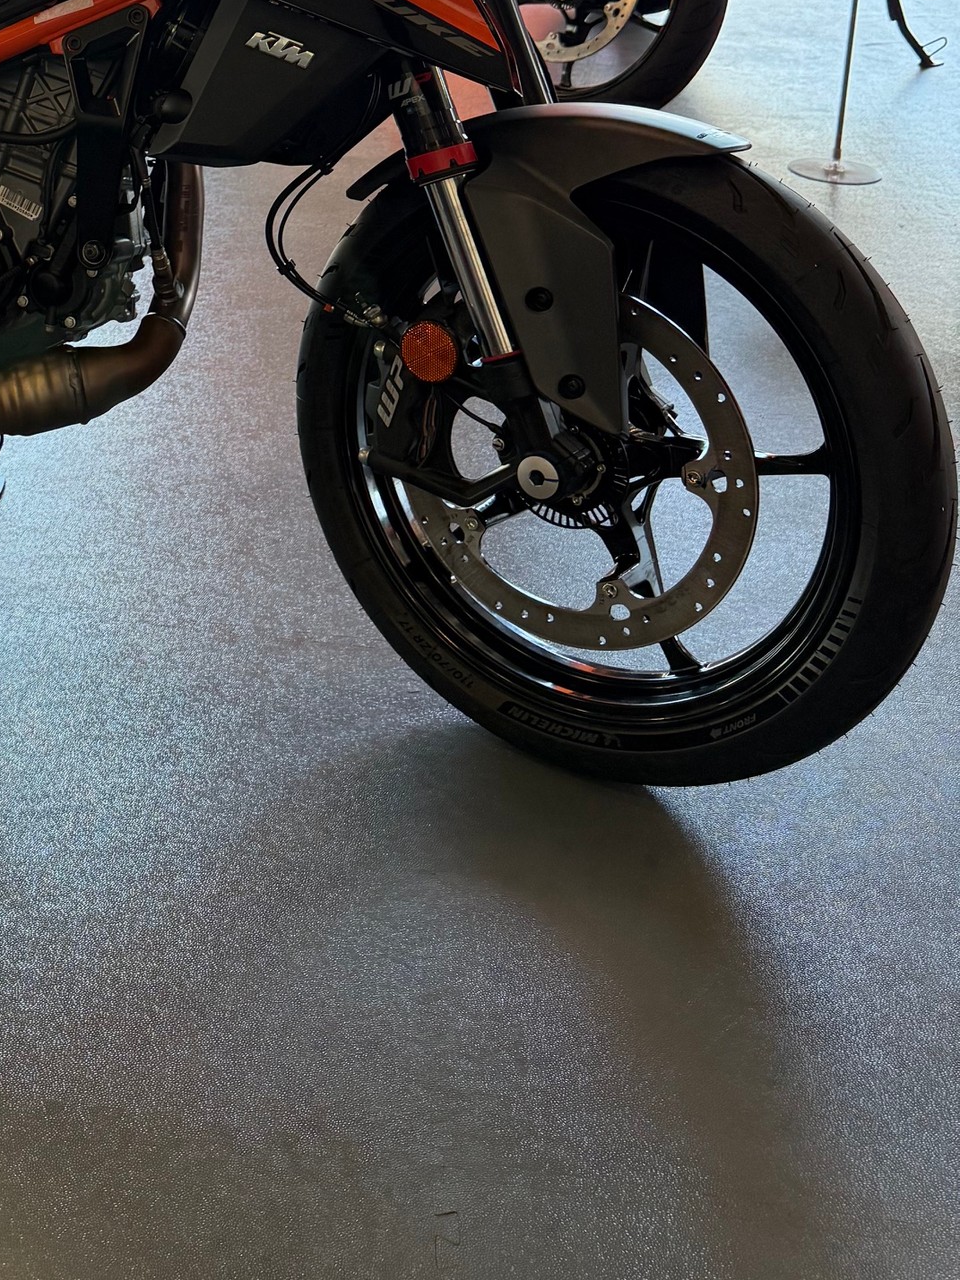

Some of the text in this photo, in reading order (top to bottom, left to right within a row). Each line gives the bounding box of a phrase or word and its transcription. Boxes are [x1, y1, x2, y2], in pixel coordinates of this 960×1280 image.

[245, 30, 316, 71] KTM
[400, 93, 426, 108] APEX
[377, 354, 404, 428] WP
[507, 705, 597, 746] MICHELIN
[723, 713, 756, 734] FRONT
